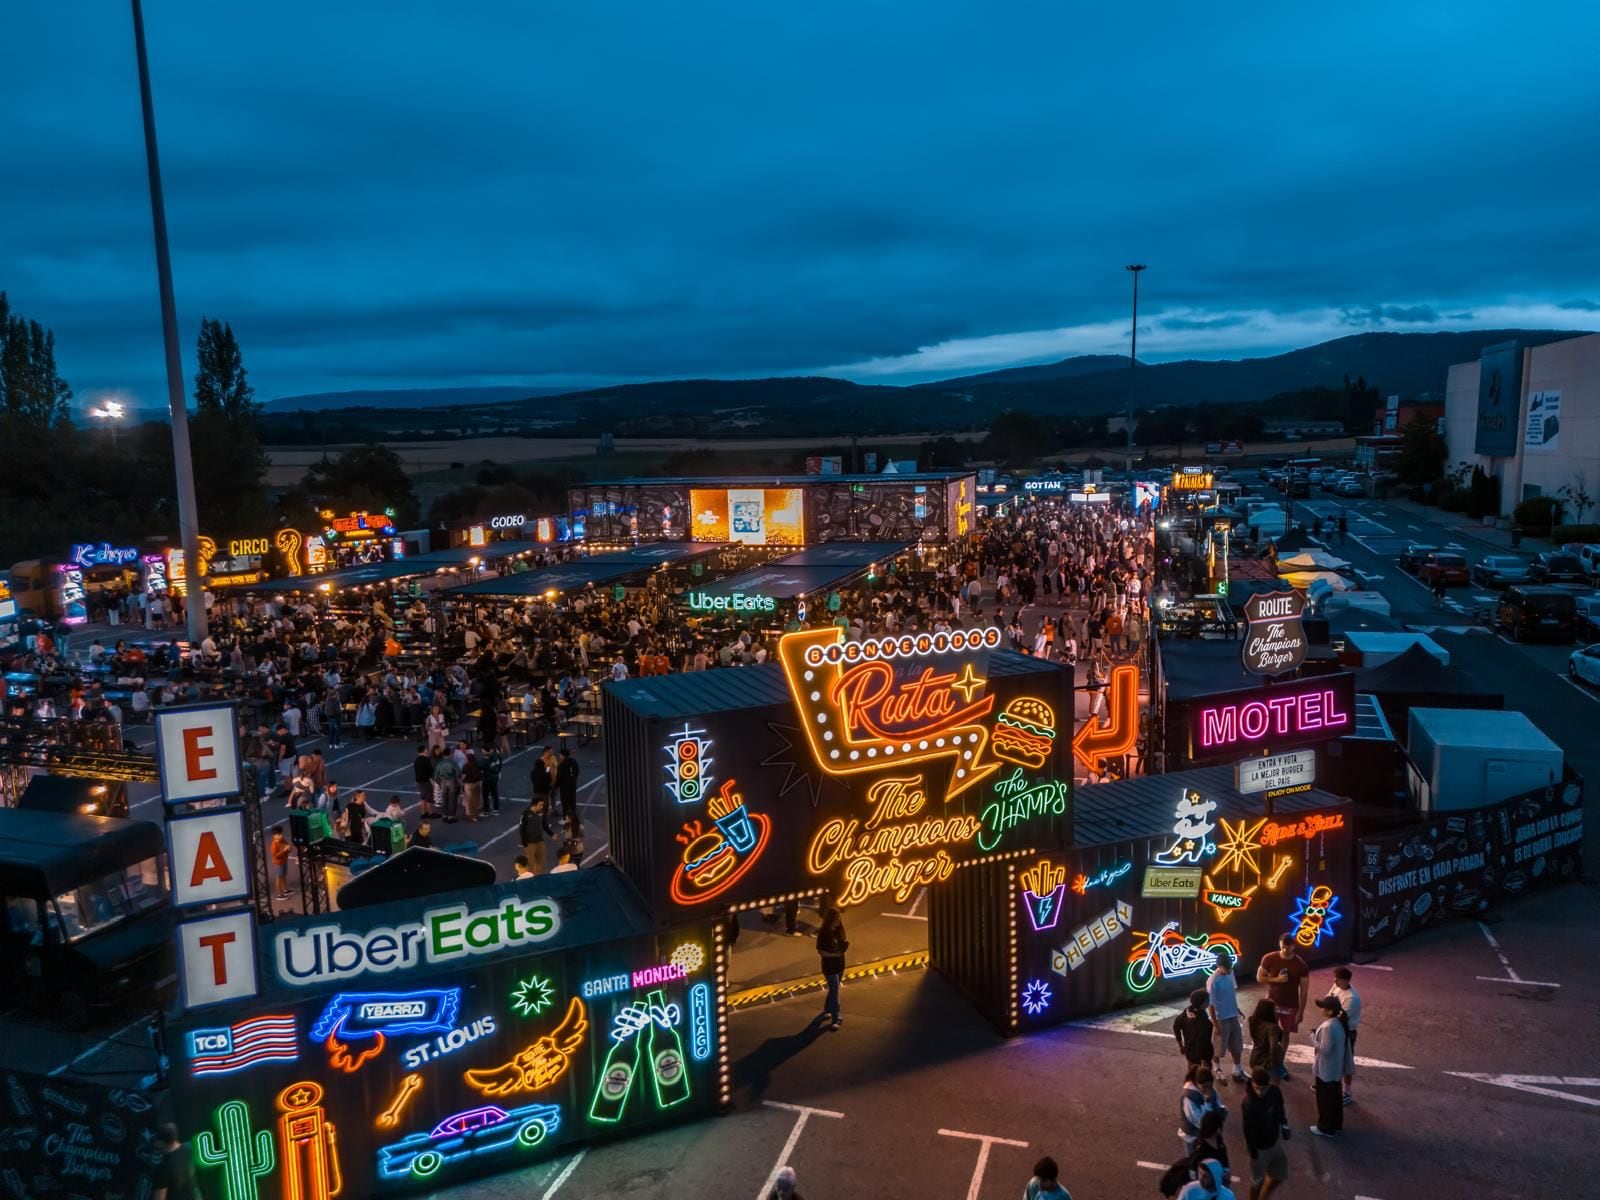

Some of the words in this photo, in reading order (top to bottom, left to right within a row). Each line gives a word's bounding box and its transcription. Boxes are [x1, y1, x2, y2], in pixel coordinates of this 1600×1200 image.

[1025, 481, 1061, 489] GOTTAN
[491, 515, 525, 528] GODEO
[231, 538, 269, 556] CIRCO
[689, 592, 731, 610] Uber
[733, 593, 775, 610] Eats
[1259, 597, 1293, 623] ROUTE
[1266, 624, 1285, 641] The
[809, 629, 998, 663] BIENVENIDOS
[1250, 637, 1301, 657] Champions
[1258, 652, 1295, 669] Burger
[832, 660, 975, 738] Ruta
[1202, 690, 1348, 747] MOTEL
[1251, 771, 1259, 781] LA
[1261, 768, 1280, 779] MEJOR
[1282, 764, 1304, 775] BURGER
[1258, 757, 1276, 770] ENTRA
[1278, 757, 1283, 767] Y
[1284, 754, 1298, 765] VOTA
[995, 767, 1028, 798] The
[1265, 778, 1276, 789] DEL
[1267, 788, 1285, 798] ENJOY
[1286, 786, 1295, 794] ON
[1295, 784, 1312, 793] MODE
[866, 774, 925, 829] The
[808, 815, 981, 876] Champions
[1367, 856, 1377, 865] 66
[836, 851, 956, 906] Burger
[1149, 877, 1172, 888] Uber
[1172, 877, 1194, 888] Eats
[1378, 871, 1418, 896] DISFRUTE
[1418, 866, 1432, 886] EN
[1452, 852, 1486, 873] PARADA
[1211, 894, 1243, 907] KANSAS
[282, 929, 419, 979] Uber
[430, 901, 555, 957] Eats
[1053, 906, 1129, 971] CHEESY
[583, 974, 630, 998] SANTA
[632, 963, 688, 989] MONICA
[364, 1003, 423, 1018] YBARRA
[694, 985, 707, 1058] CHICAGO
[195, 1034, 228, 1052] TCB
[65, 1121, 94, 1144] The
[44, 1132, 121, 1165] Champions
[60, 1154, 113, 1182] Burger
